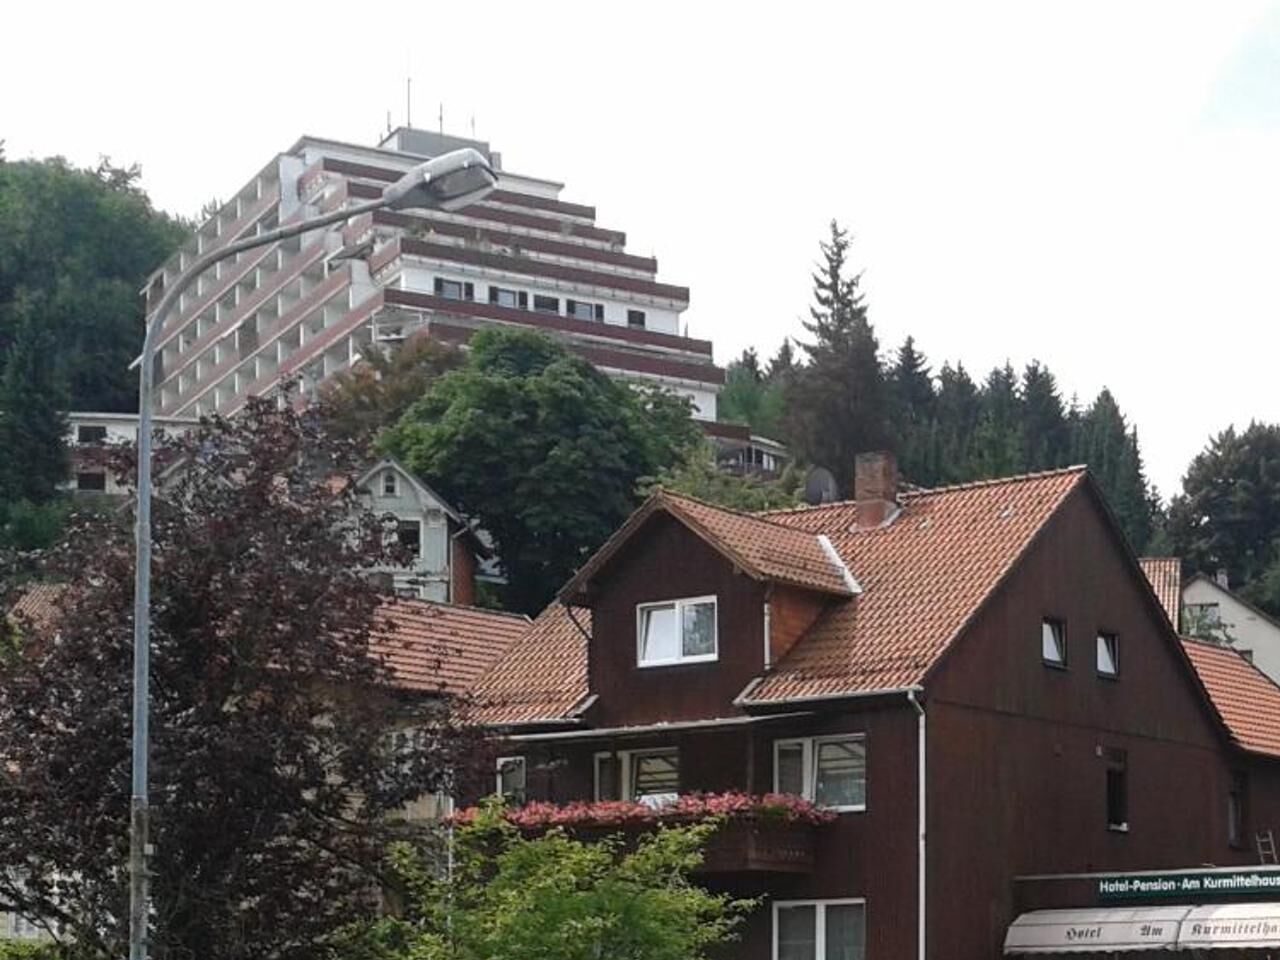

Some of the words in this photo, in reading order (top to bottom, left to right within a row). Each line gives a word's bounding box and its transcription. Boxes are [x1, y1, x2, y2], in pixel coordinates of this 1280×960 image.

[1099, 879, 1176, 893] Hotel-Pension
[1181, 877, 1200, 890] Am
[1139, 924, 1163, 937] Am
